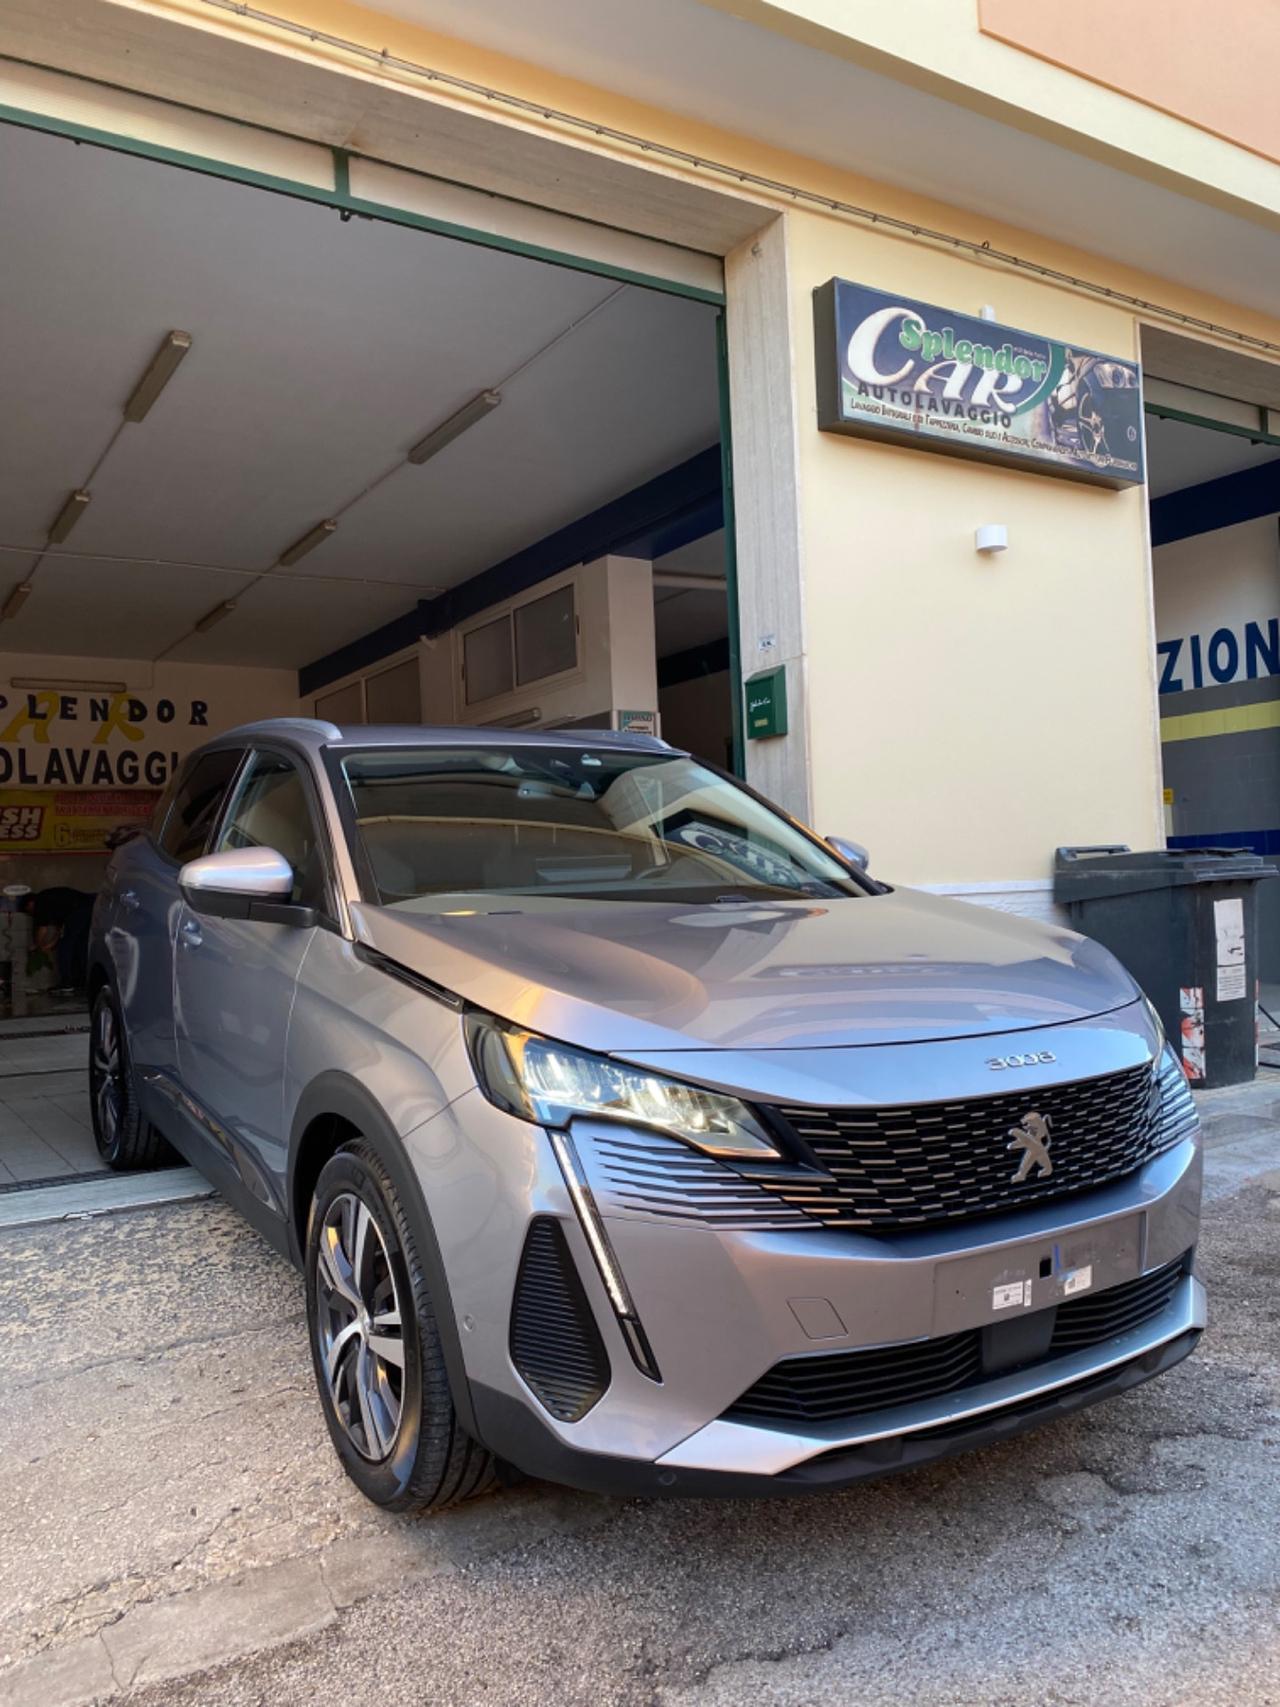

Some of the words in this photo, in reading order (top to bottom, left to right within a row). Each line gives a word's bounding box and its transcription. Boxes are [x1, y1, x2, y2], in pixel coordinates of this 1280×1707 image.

[847, 306, 1024, 414] CAR
[899, 317, 1047, 382] Splendor
[857, 381, 1012, 429] AUTOLAVAGGIO
[1157, 617, 1280, 694] ZION
[0, 807, 42, 825] SH
[984, 1051, 1056, 1071] 3008
